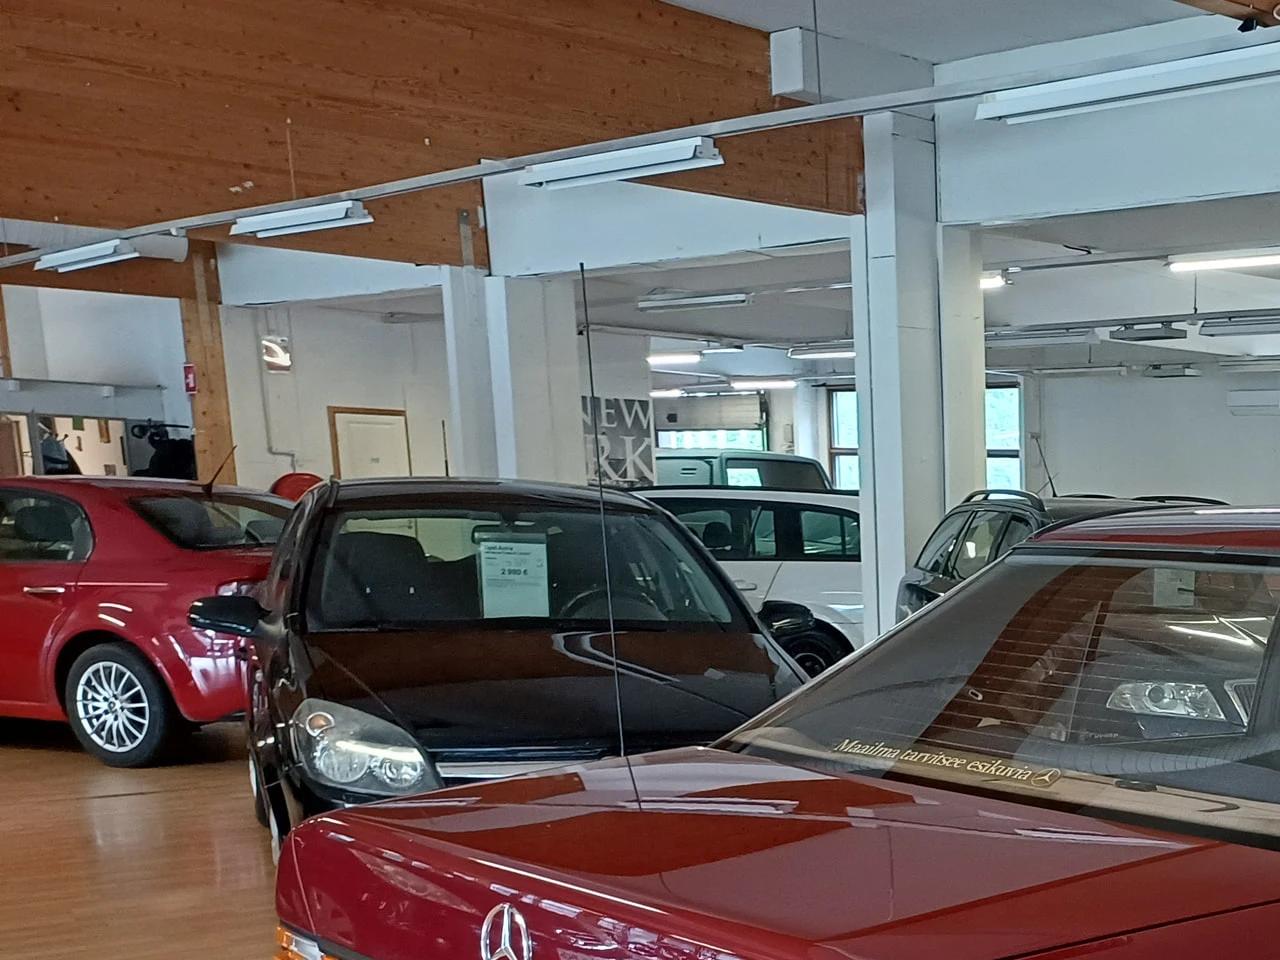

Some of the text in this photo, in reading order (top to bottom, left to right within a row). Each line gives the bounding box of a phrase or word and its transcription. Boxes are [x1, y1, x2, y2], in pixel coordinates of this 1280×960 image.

[834, 739, 1033, 780] Maailma tarvitsee esikuvia
